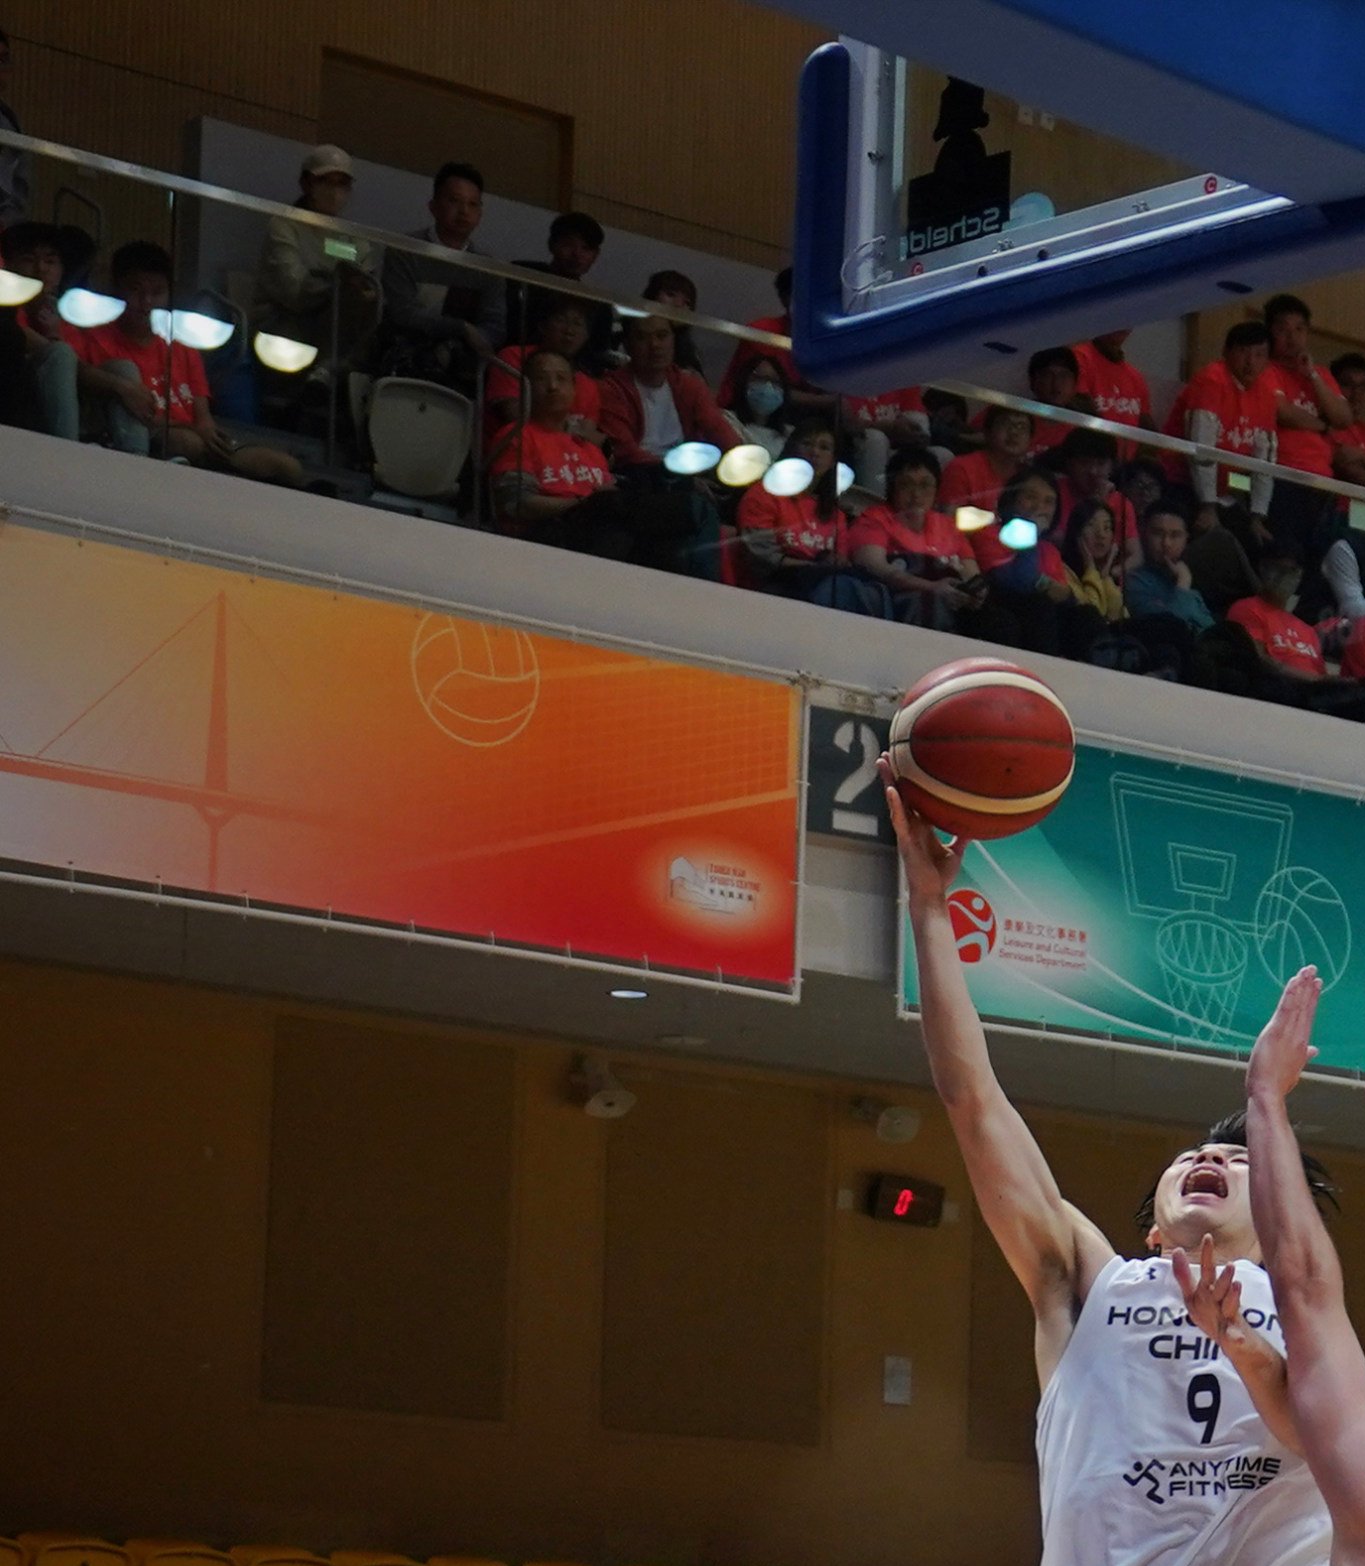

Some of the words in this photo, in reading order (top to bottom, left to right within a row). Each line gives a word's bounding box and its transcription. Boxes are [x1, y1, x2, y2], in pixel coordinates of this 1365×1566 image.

[832, 720, 880, 836] 2
[1148, 1334, 1220, 1360] CHI
[1187, 1373, 1222, 1444] 9
[1169, 1456, 1281, 1477] ANYTIME
